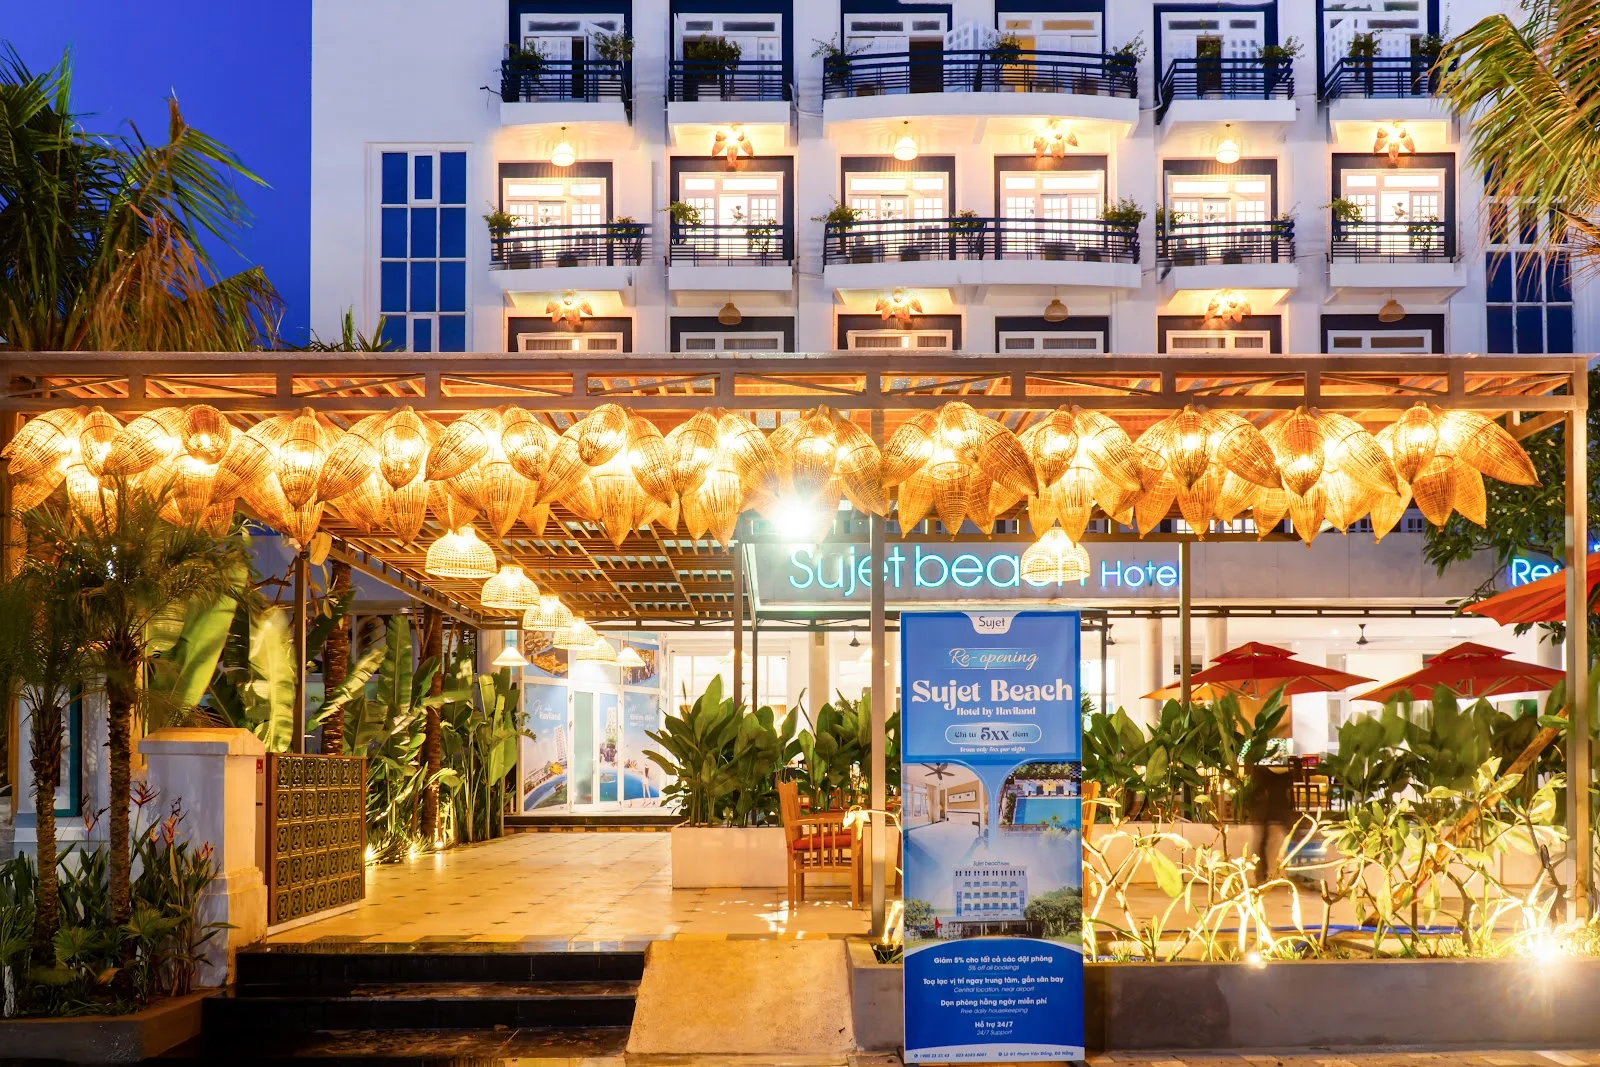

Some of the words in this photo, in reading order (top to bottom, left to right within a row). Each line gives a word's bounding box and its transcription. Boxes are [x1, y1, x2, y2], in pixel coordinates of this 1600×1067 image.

[789, 546, 906, 597] Sujet
[915, 546, 1086, 588] beach
[1101, 560, 1180, 587] Hote
[979, 616, 1005, 629] Sujet
[949, 648, 1038, 670] Re-opening
[912, 679, 981, 710] Sujet
[991, 678, 1072, 701] Beach
[956, 707, 979, 716] Hotel
[982, 707, 993, 717] by
[996, 707, 1036, 716] Haviland
[981, 727, 1009, 741] 5xx
[1011, 746, 1026, 754] night
[981, 955, 990, 963] tất
[1030, 955, 1053, 964] phòng
[936, 978, 948, 987] lạc
[965, 978, 983, 986] ngay
[1050, 976, 1064, 984] bay
[1015, 985, 1035, 993] airport
[940, 999, 954, 1007] Dọn
[955, 999, 978, 1007] phòng
[998, 998, 1016, 1006] ngày
[1035, 997, 1048, 1005] phí
[986, 1021, 996, 1029] trợ
